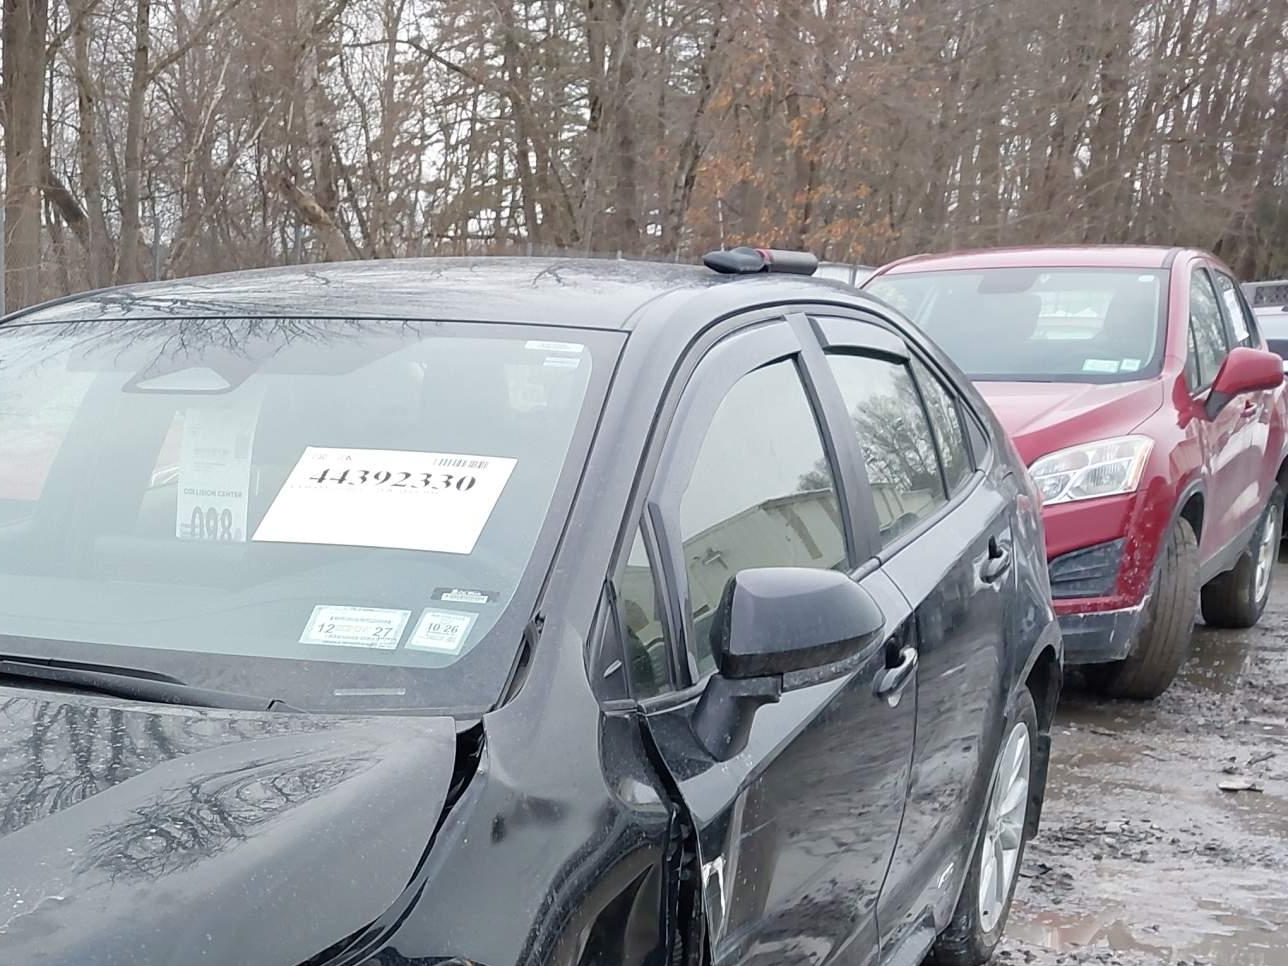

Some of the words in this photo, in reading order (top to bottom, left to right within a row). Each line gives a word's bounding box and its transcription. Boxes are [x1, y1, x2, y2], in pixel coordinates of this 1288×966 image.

[309, 468, 476, 492] 44392330
[317, 622, 335, 634] 12
[372, 626, 393, 638] 27
